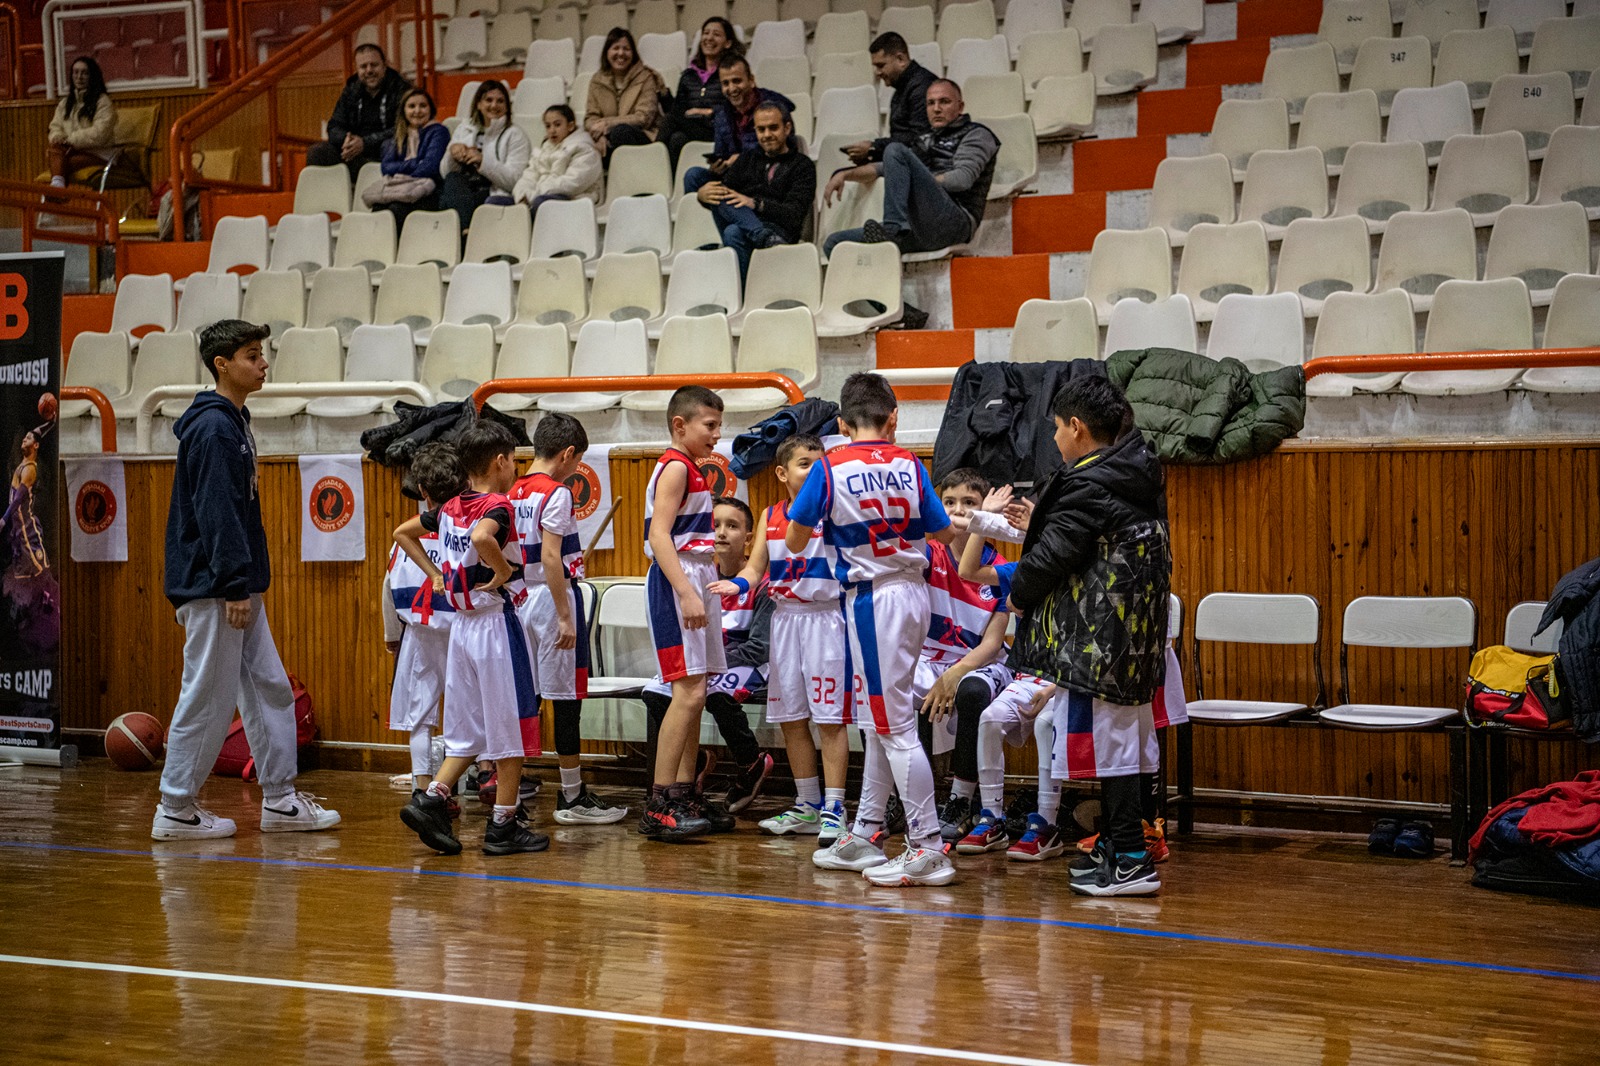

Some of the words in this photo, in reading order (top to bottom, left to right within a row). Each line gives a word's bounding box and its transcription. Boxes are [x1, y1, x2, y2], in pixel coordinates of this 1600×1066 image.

[1523, 87, 1542, 98] B40
[0, 273, 29, 340] B
[0, 357, 49, 386] UNCUSU
[846, 470, 914, 498] ÇINAR
[858, 497, 914, 557] 22
[783, 557, 807, 583] 32
[411, 577, 434, 626] 4
[15, 669, 52, 699] CAMP
[811, 676, 836, 705] 32
